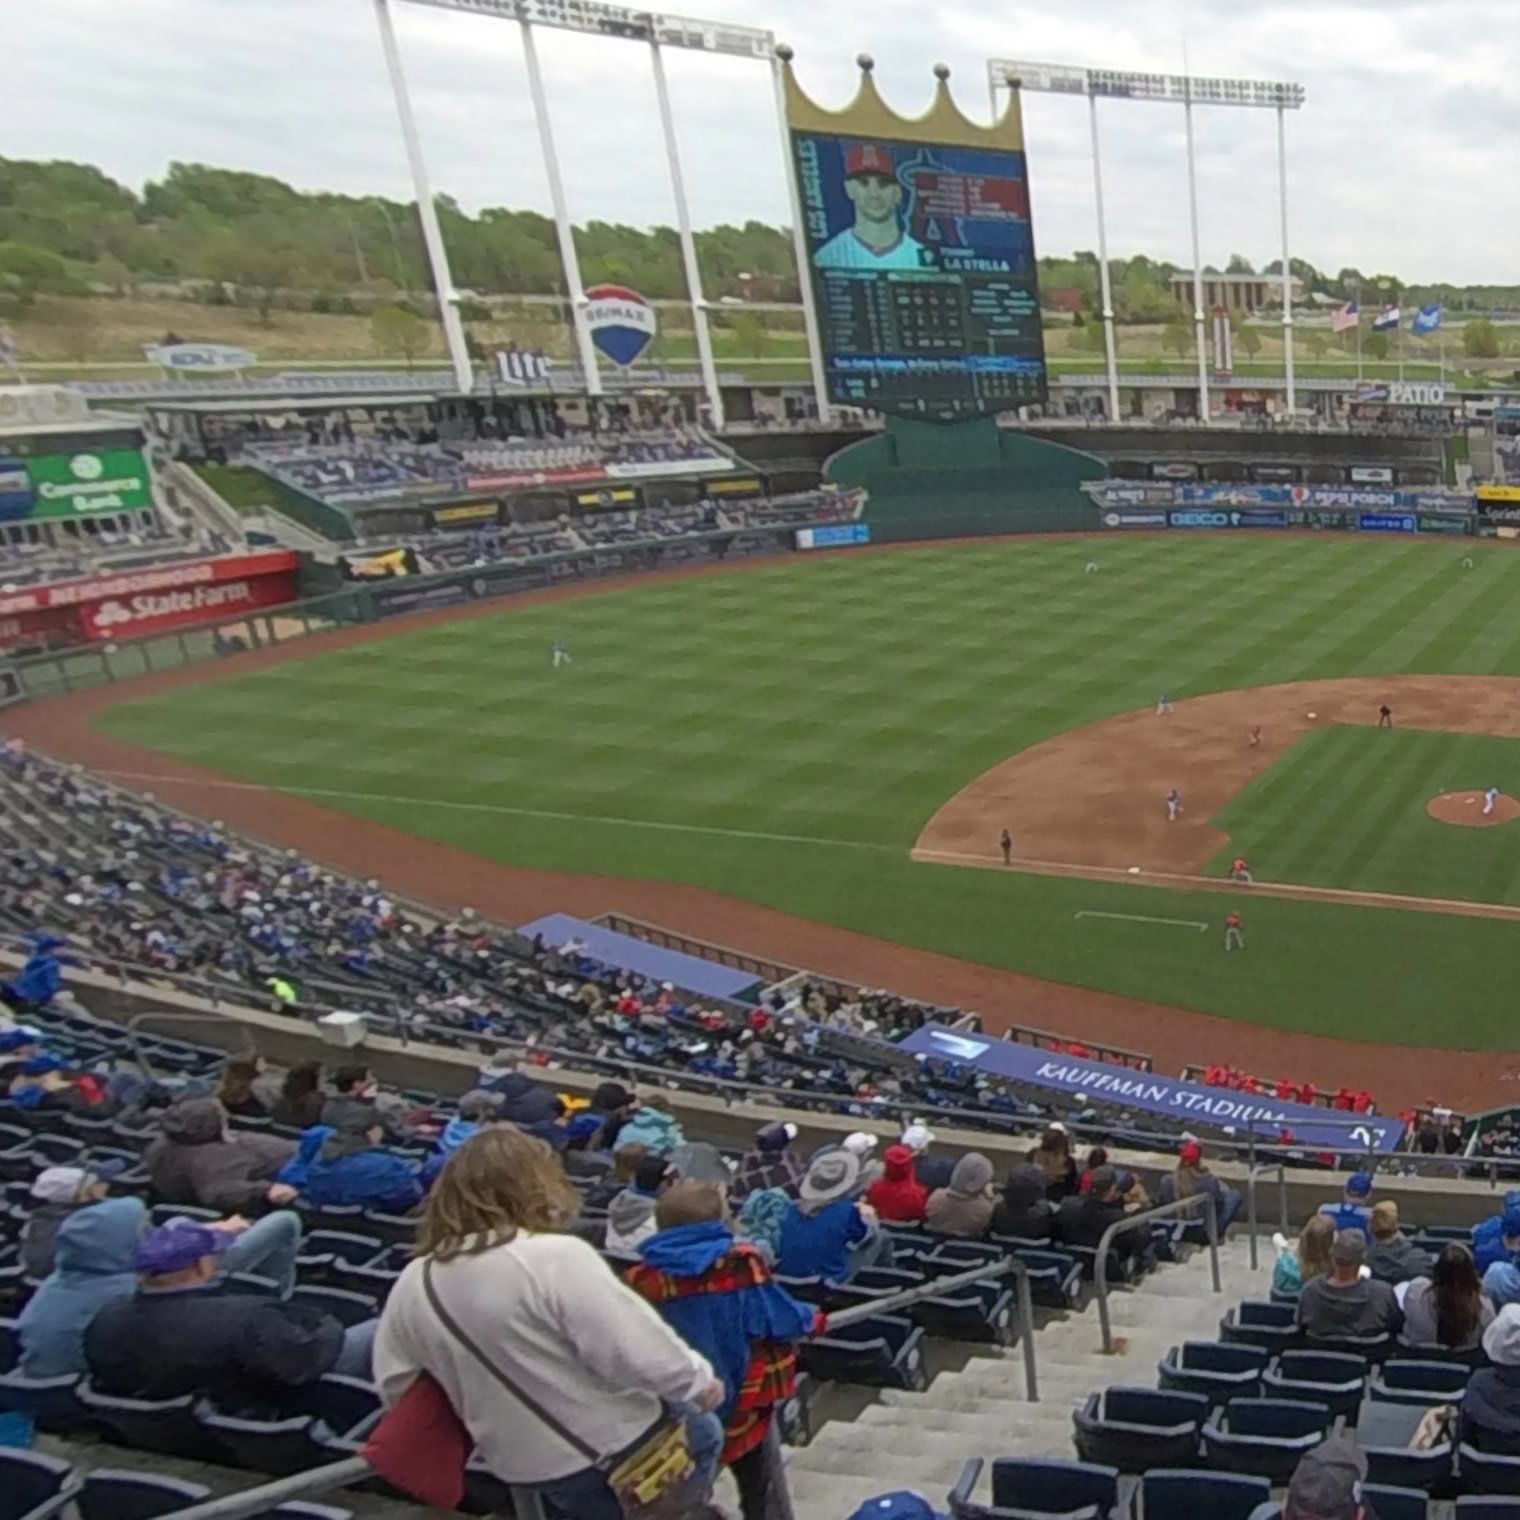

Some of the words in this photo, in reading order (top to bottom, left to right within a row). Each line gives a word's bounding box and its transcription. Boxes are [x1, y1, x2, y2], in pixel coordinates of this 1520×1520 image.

[944, 258, 961, 270] LA
[963, 259, 1010, 273] STELLA
[1390, 382, 1445, 405] PATIO
[39, 478, 141, 499] Commerce
[72, 493, 124, 512] Bank
[1171, 512, 1227, 526] GEICO
[1036, 1062, 1168, 1102] KAUFFMAN
[1168, 1090, 1287, 1129] STADIUM
